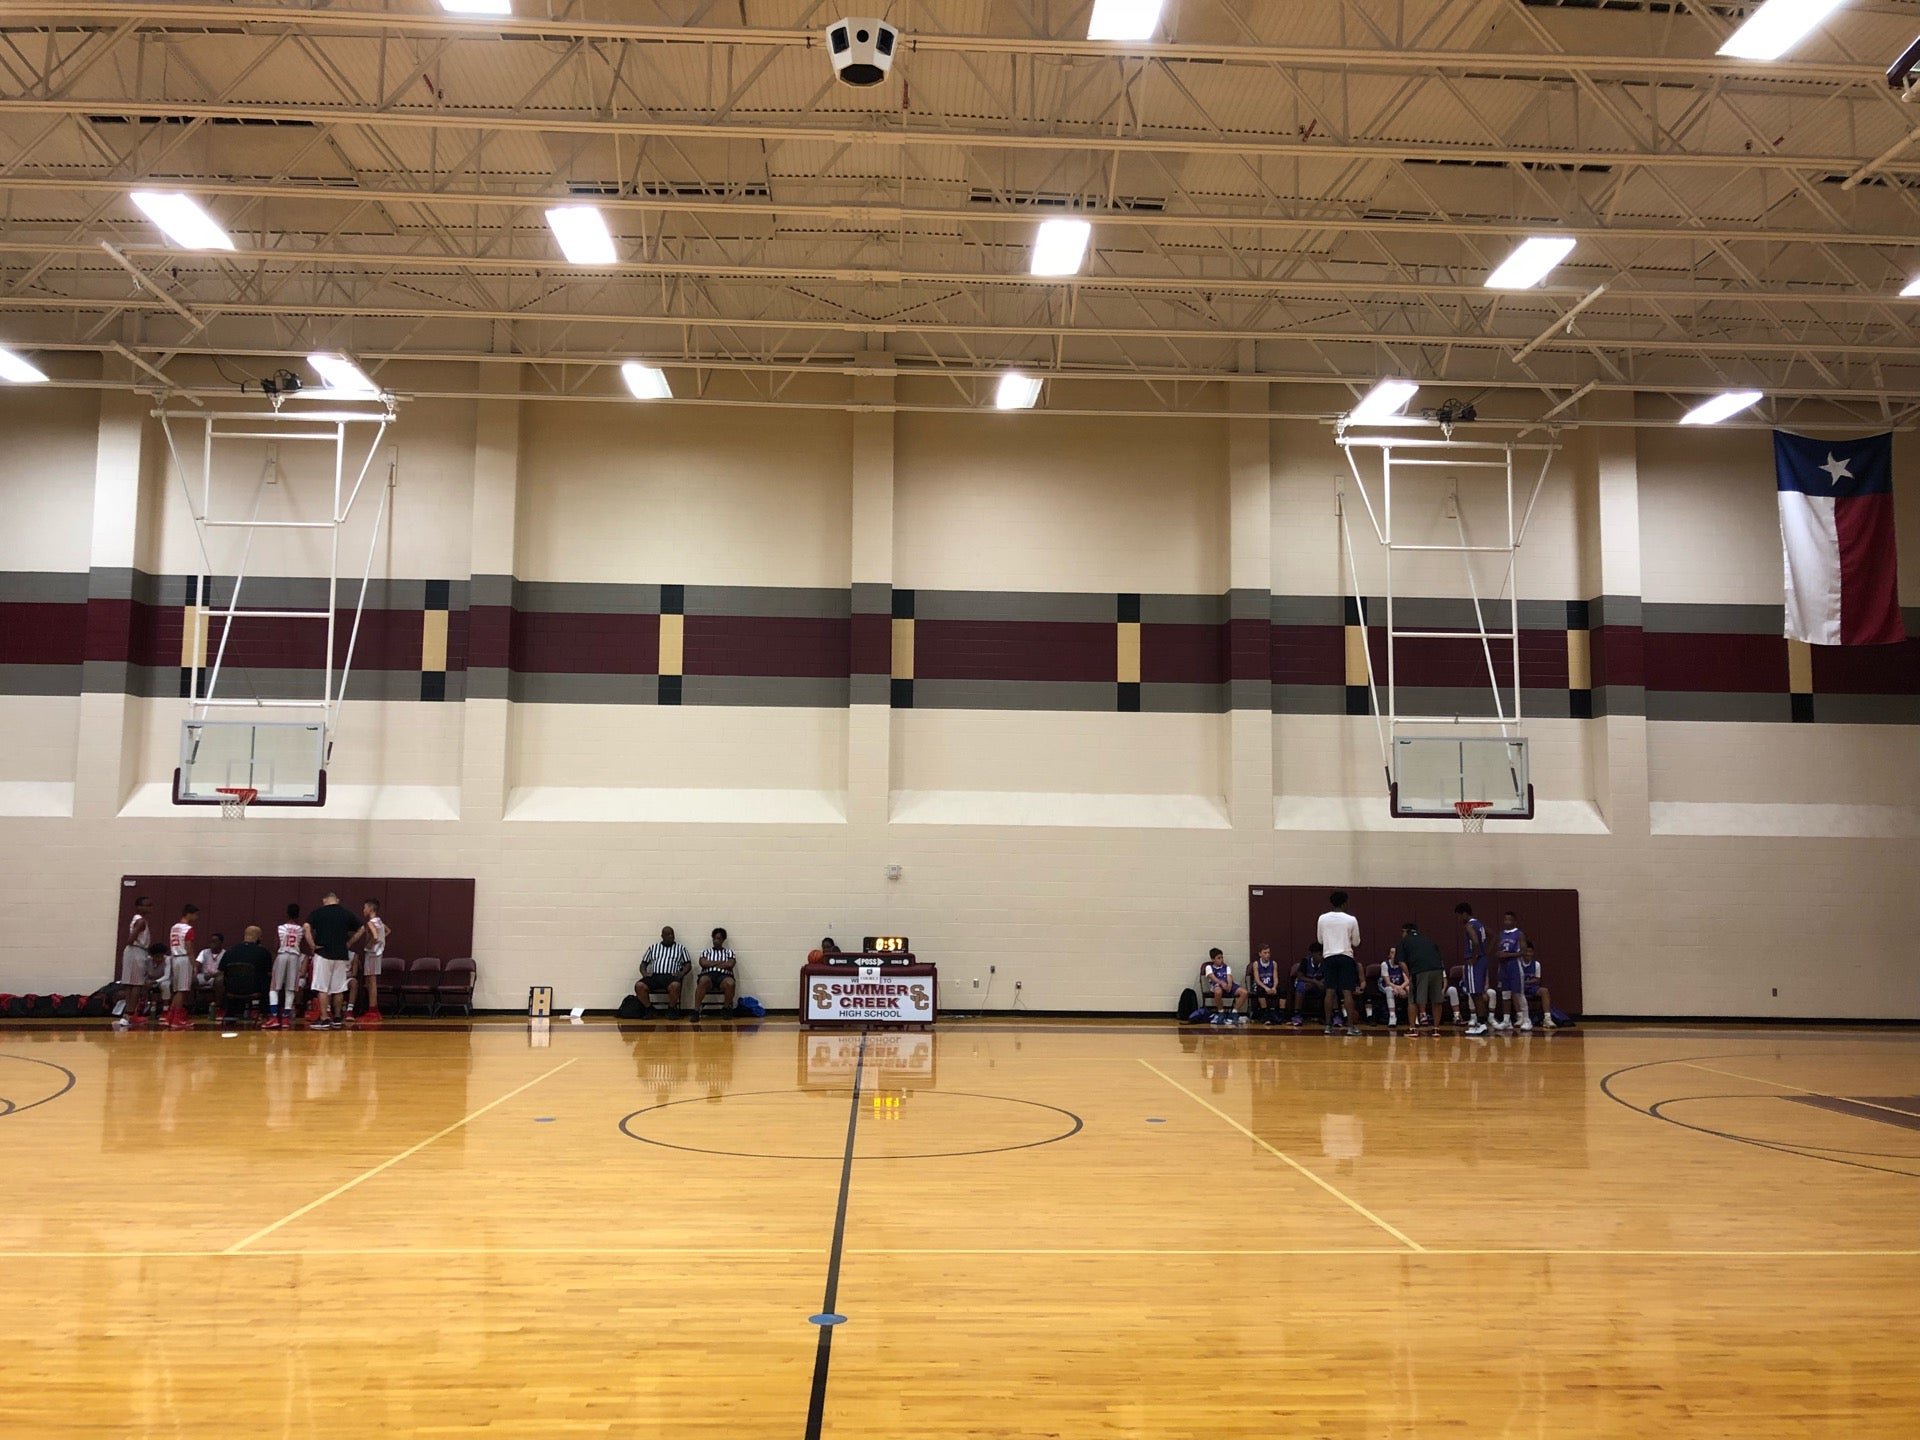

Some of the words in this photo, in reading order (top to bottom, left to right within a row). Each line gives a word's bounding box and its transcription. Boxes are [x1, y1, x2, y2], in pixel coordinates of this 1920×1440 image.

[286, 934, 297, 947] 12
[876, 938, 903, 951] 0:57
[861, 958, 878, 966] POSS
[830, 984, 909, 996] SUMMER
[840, 997, 901, 1010] CREEK
[839, 1010, 861, 1018] HIGH
[864, 1010, 902, 1018] SCHOOL
